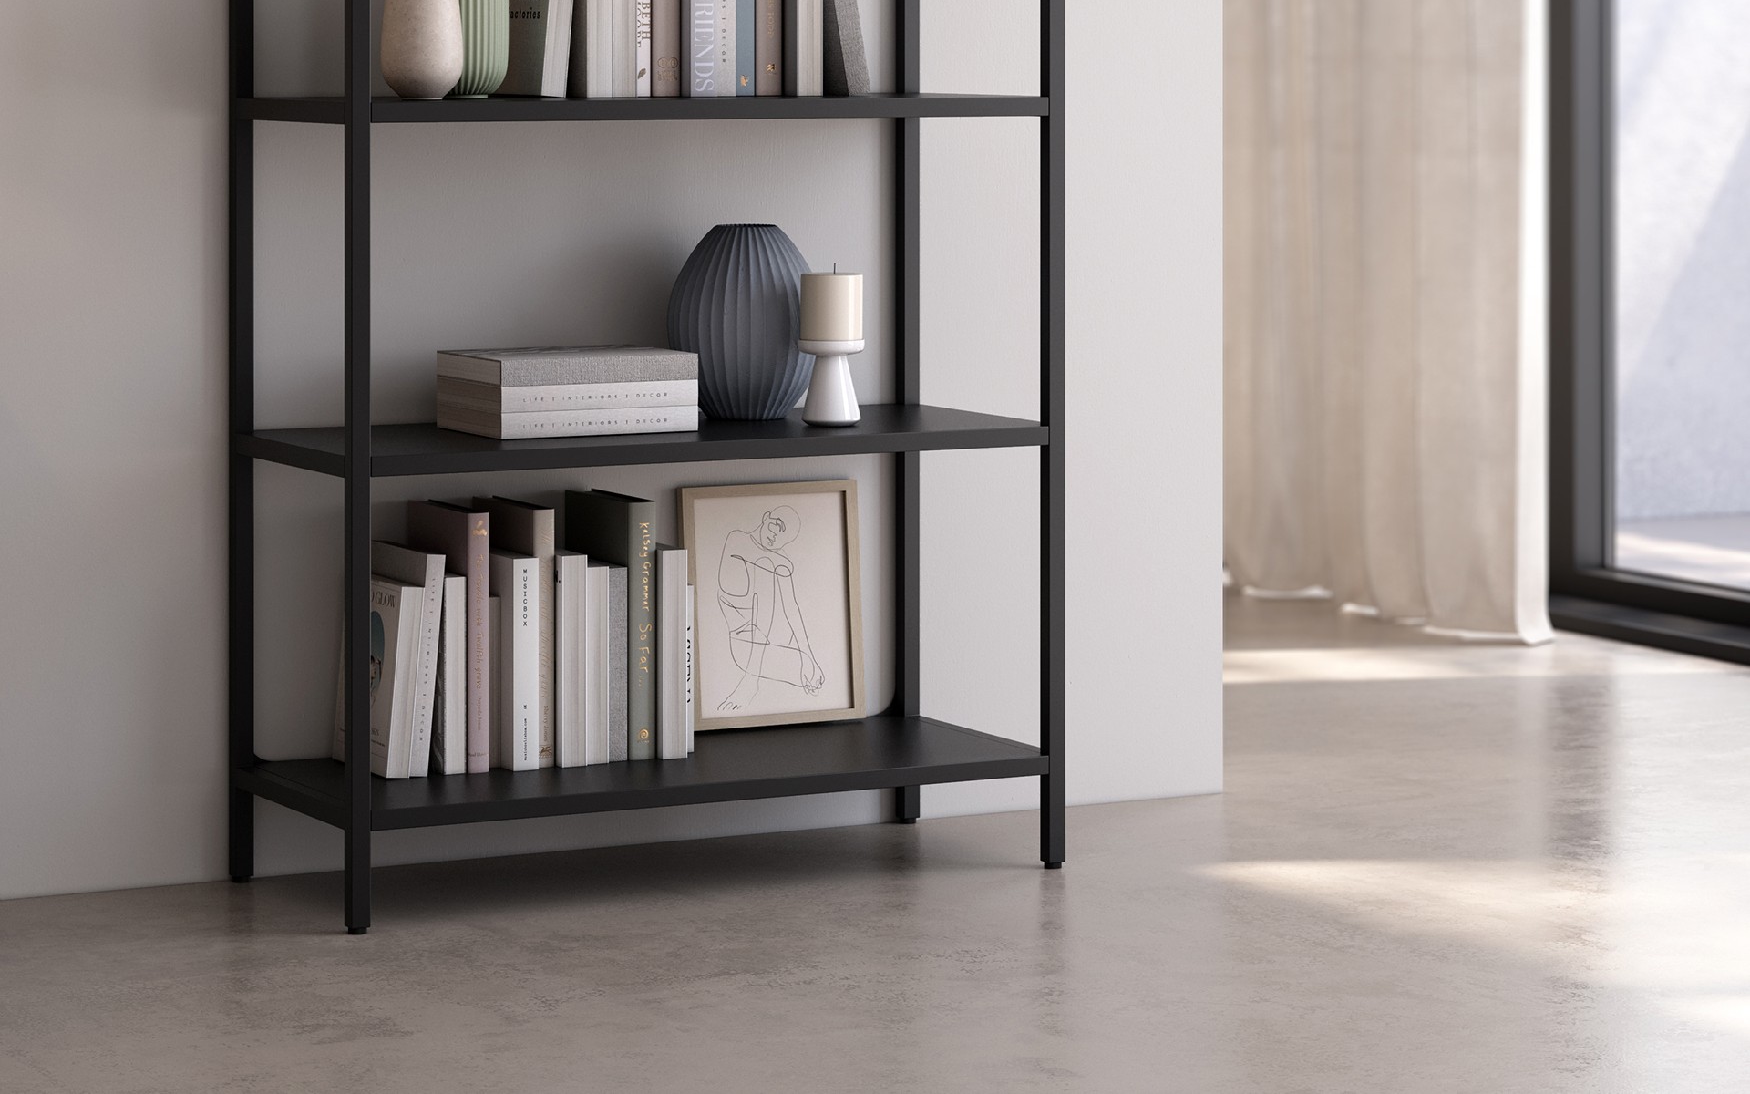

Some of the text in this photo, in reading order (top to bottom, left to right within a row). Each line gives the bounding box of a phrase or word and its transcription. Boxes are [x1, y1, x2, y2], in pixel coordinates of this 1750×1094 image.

[642, 1, 651, 40] BETH
[562, 419, 618, 427] INTERIORS
[638, 521, 651, 612] Kelsey Grammer
[639, 623, 652, 641] So
